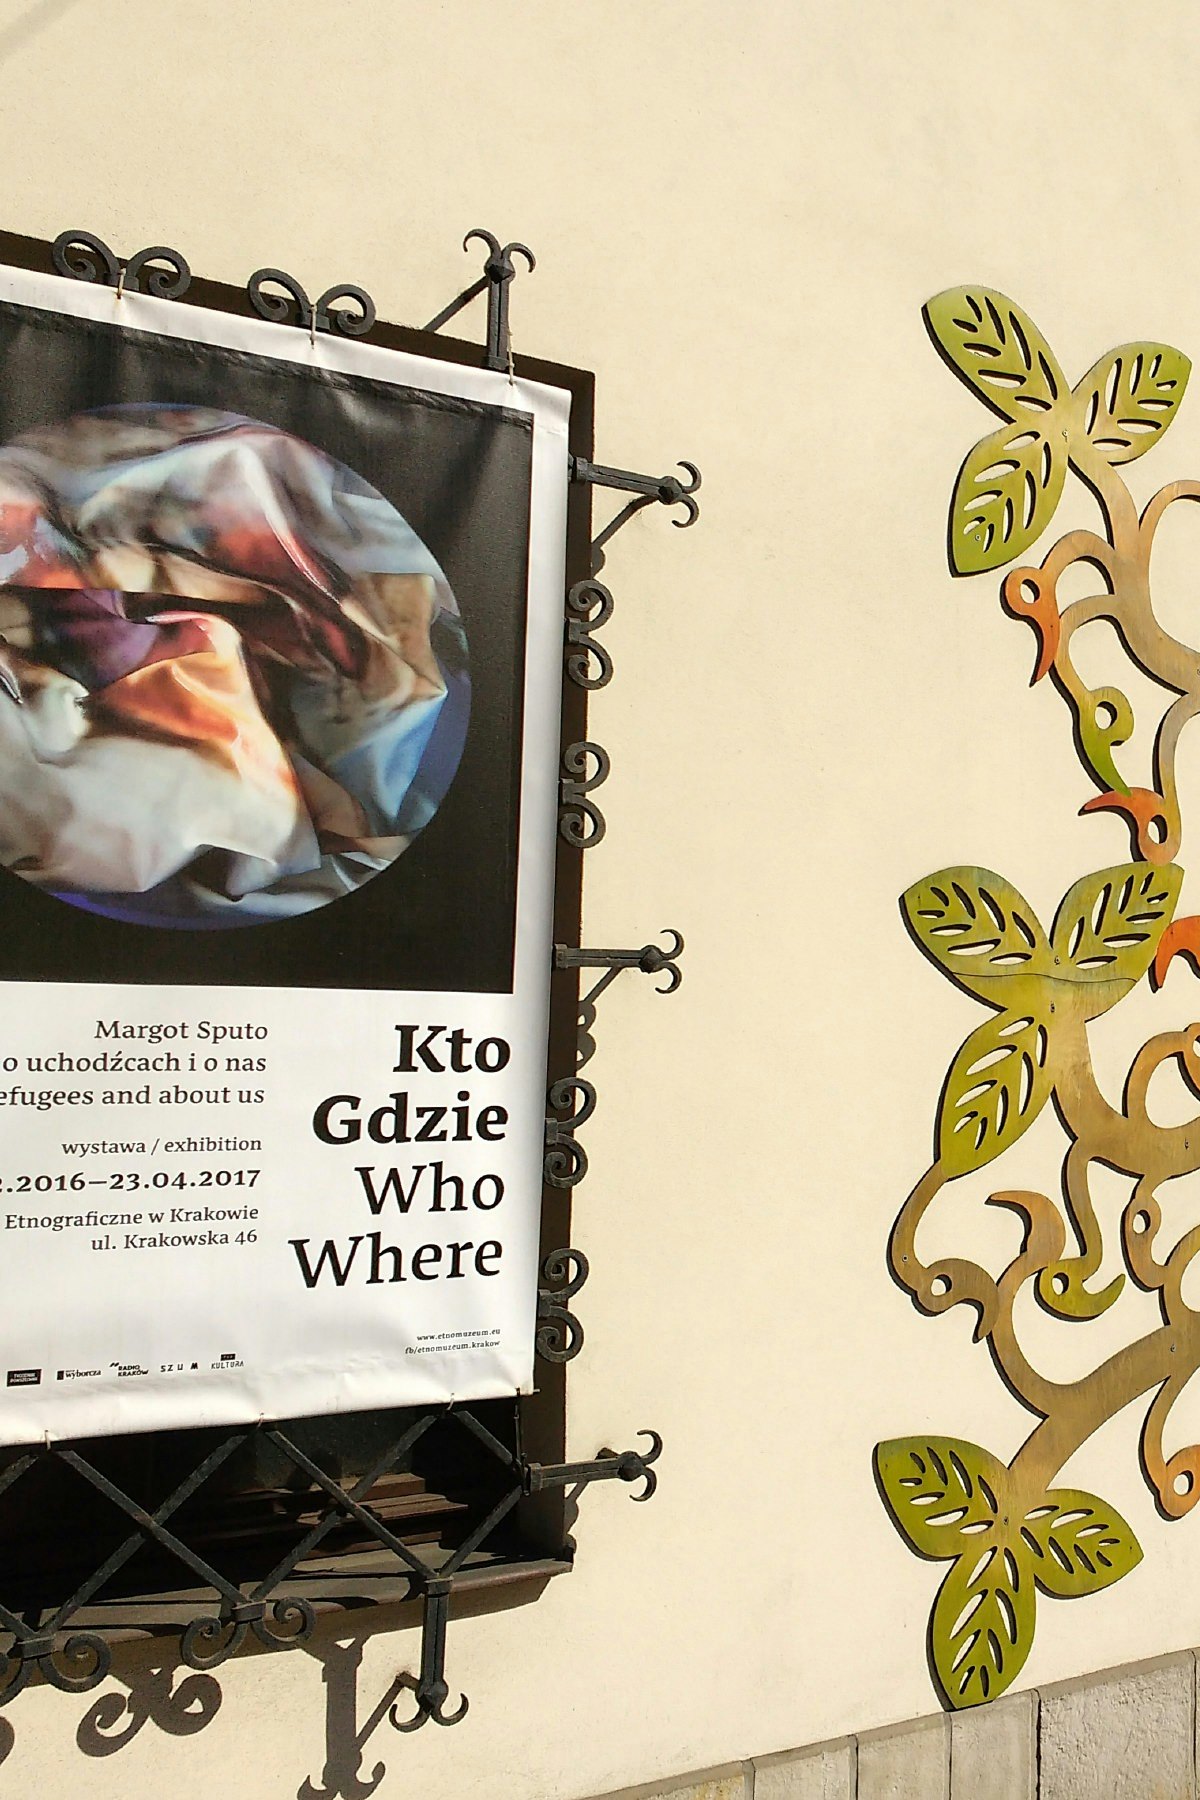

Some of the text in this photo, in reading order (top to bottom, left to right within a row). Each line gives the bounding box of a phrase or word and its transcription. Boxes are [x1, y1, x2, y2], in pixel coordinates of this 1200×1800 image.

[94, 1020, 268, 1044] Margot Sputo
[392, 1024, 511, 1073] Kto
[2, 1050, 267, 1072] o uchodźcach i o nas
[102, 1085, 152, 1105] and
[159, 1085, 231, 1105] about
[237, 1088, 265, 1104] us
[312, 1090, 509, 1145] Gdzie
[61, 1136, 262, 1158] wystawa / exhibition
[0, 1169, 261, 1193] .2016–23.04.2017
[354, 1161, 505, 1215] Who
[4, 1205, 259, 1232] Etnograficzne w Krakowie
[91, 1229, 258, 1250] ul. Krakowska 46
[287, 1231, 503, 1289] Where
[416, 1328, 501, 1341] www.etnomuzeum.eu
[404, 1340, 501, 1355] fb/etnomuzeum.krakow
